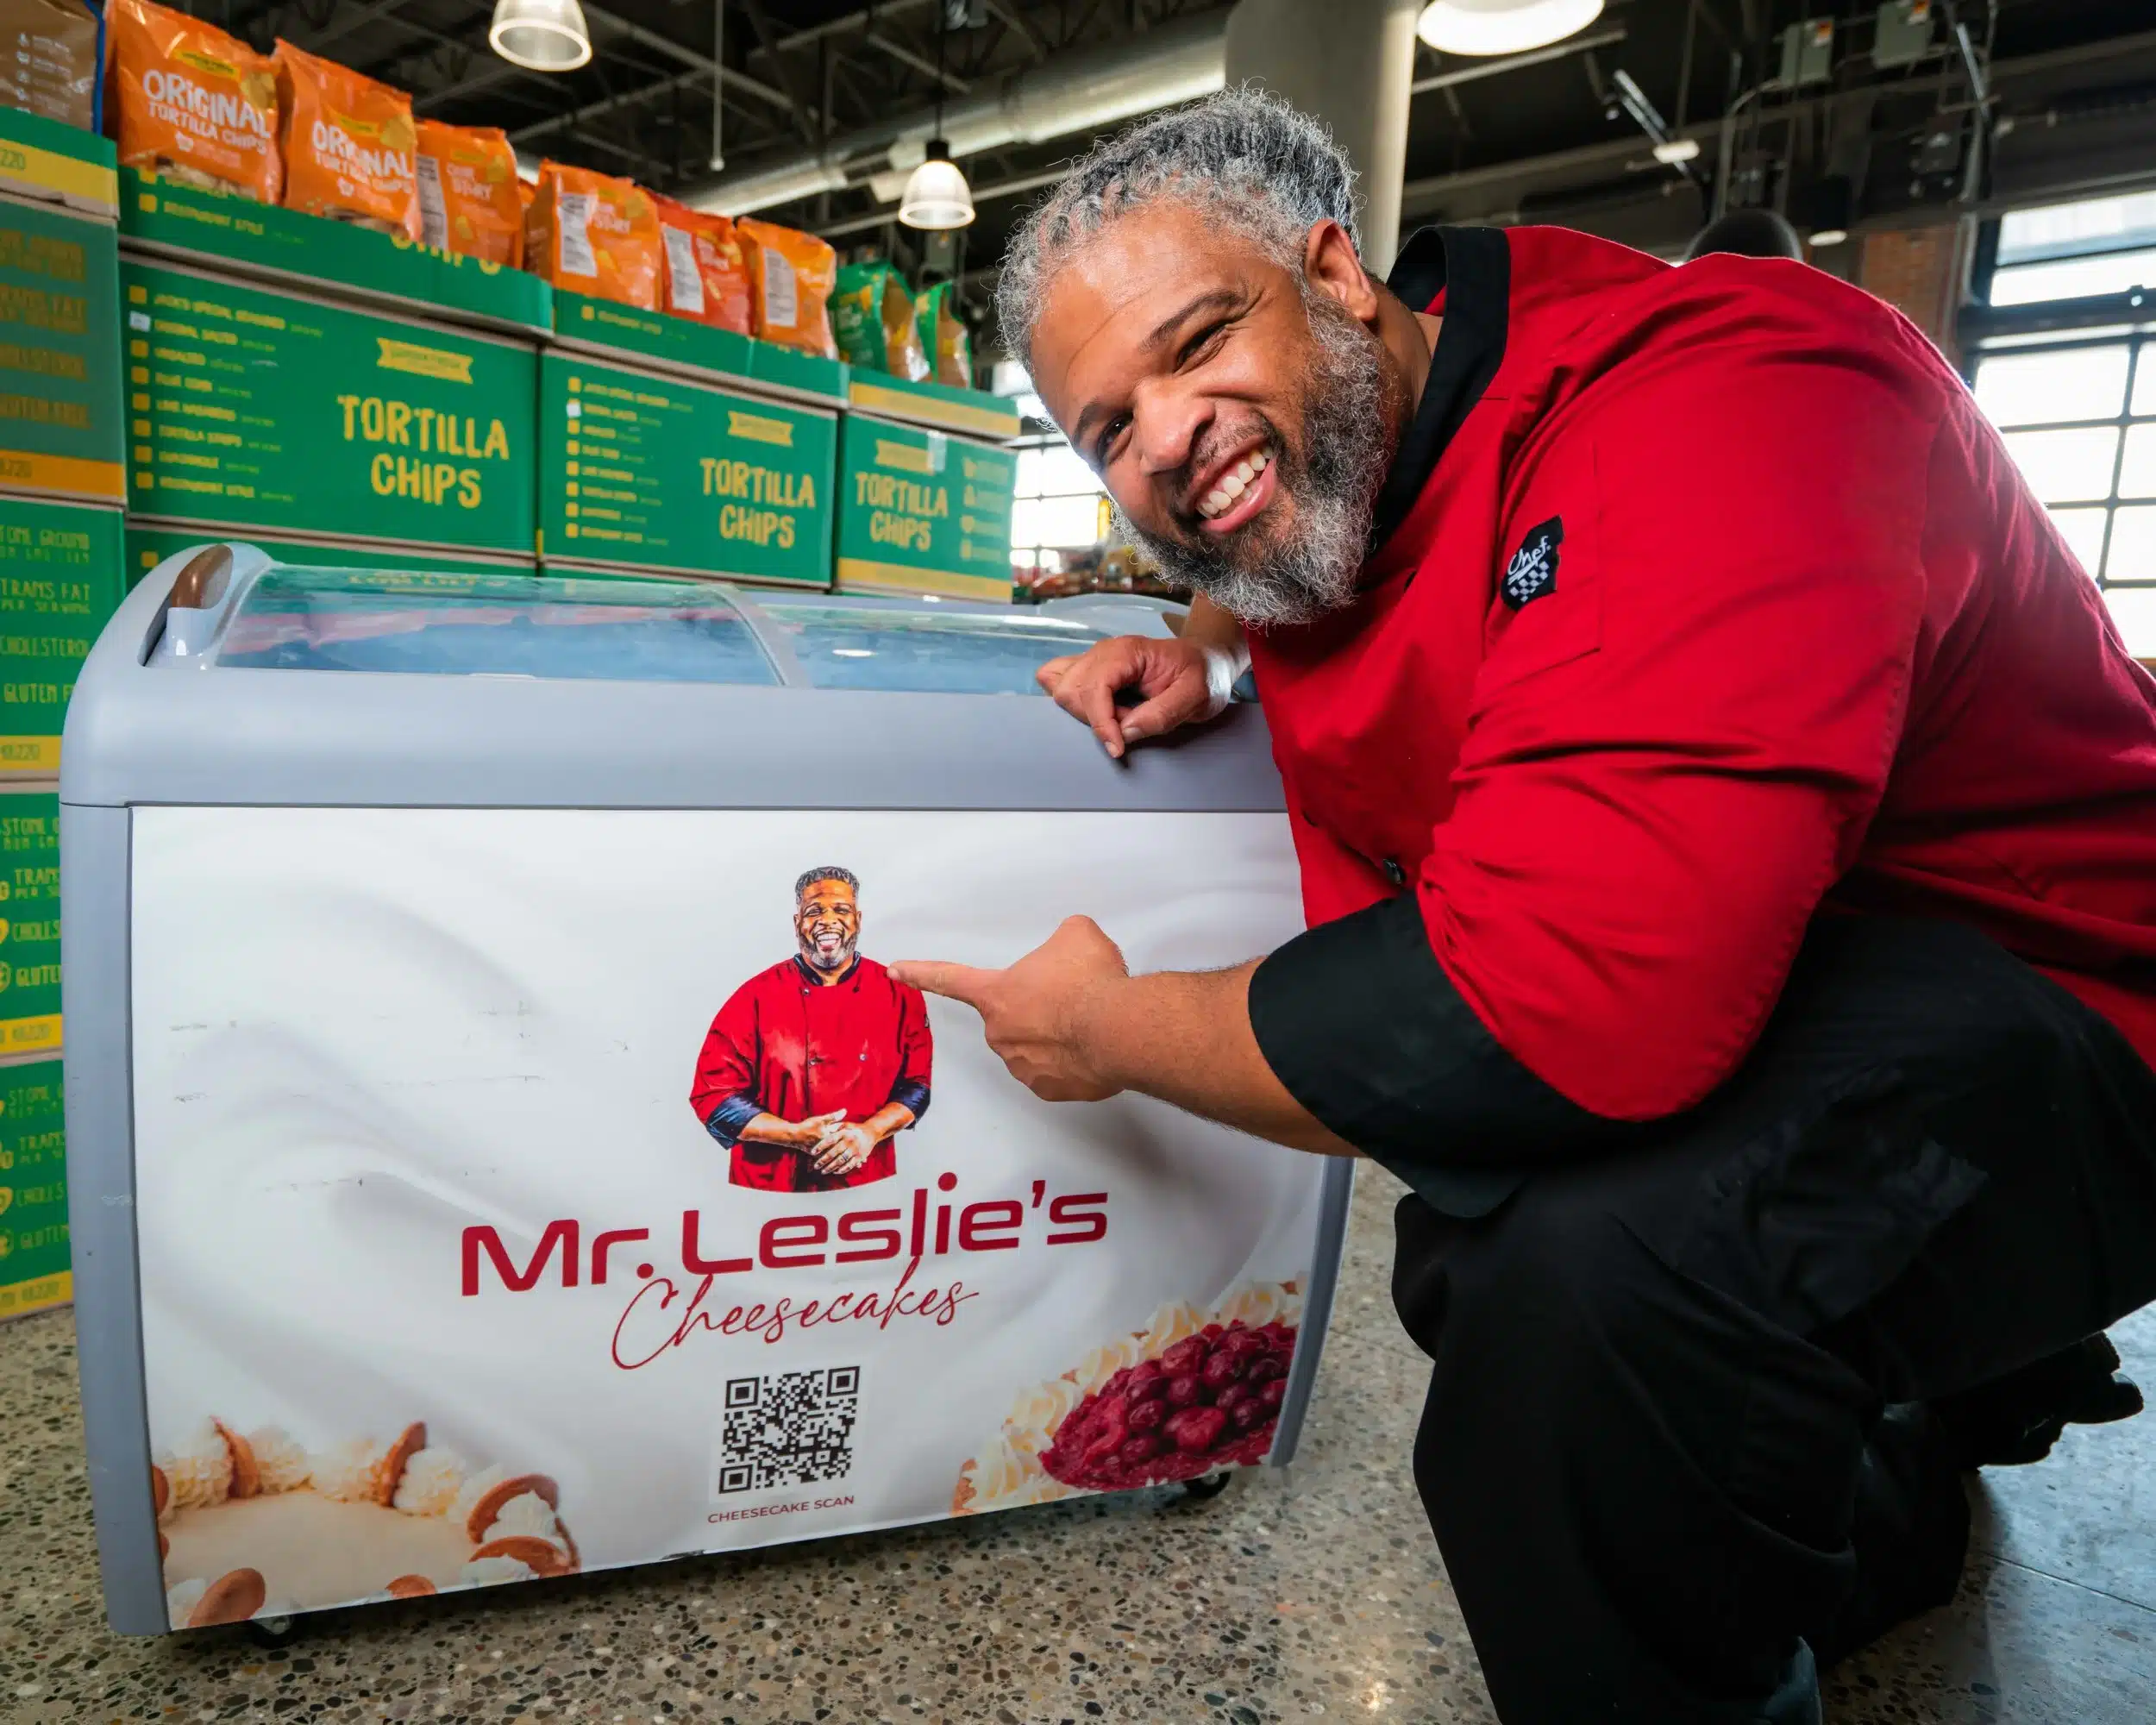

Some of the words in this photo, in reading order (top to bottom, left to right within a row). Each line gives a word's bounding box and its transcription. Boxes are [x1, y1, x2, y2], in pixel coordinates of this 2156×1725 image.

[142, 69, 272, 139] ORIGINAL
[149, 99, 218, 141] TORTILLA
[221, 129, 267, 155] CHIPS
[337, 394, 511, 460] TORTILLA
[371, 453, 483, 509] CHIPS
[699, 457, 816, 510] TORTILLA
[856, 472, 949, 518] TORTILLA
[719, 504, 796, 549] CHIPS
[869, 511, 932, 553] CHIPS
[461, 1219, 654, 1296] Mr.
[681, 1171, 1109, 1276] Leslie's
[611, 1256, 981, 1371] Cheesecakes
[707, 1501, 811, 1524] CHEESECAKE
[813, 1495, 856, 1510] SCAN
